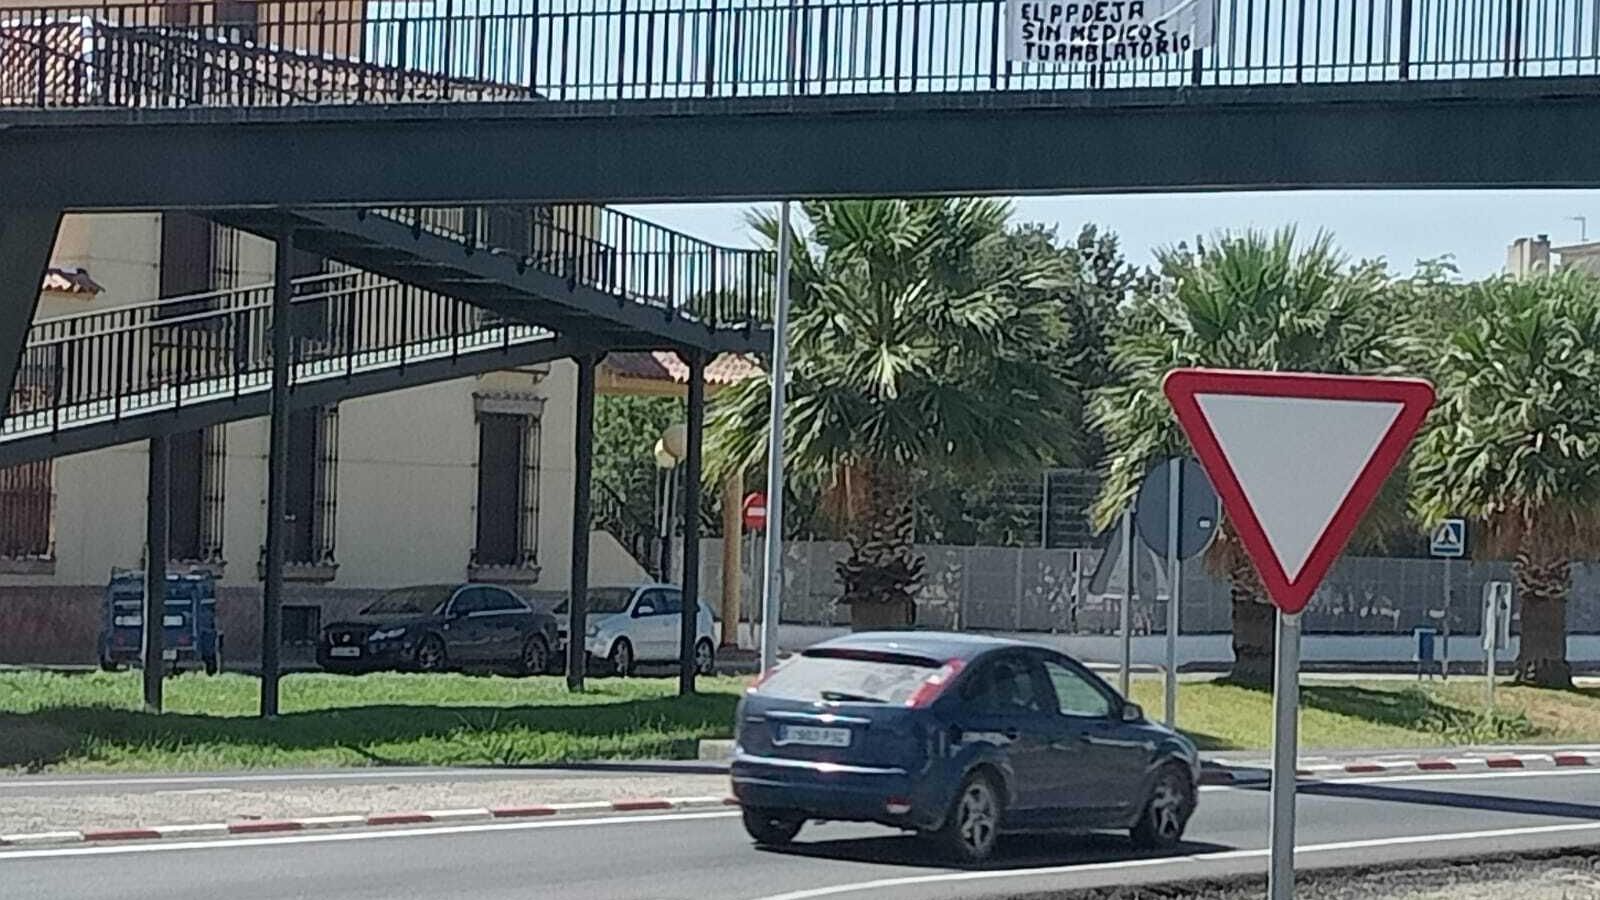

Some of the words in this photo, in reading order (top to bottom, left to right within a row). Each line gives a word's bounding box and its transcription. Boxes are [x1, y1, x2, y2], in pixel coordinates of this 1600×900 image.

[1081, 1, 1145, 23] DEJA
[1021, 21, 1061, 42] SIN
[1069, 20, 1168, 42] MEDICOS
